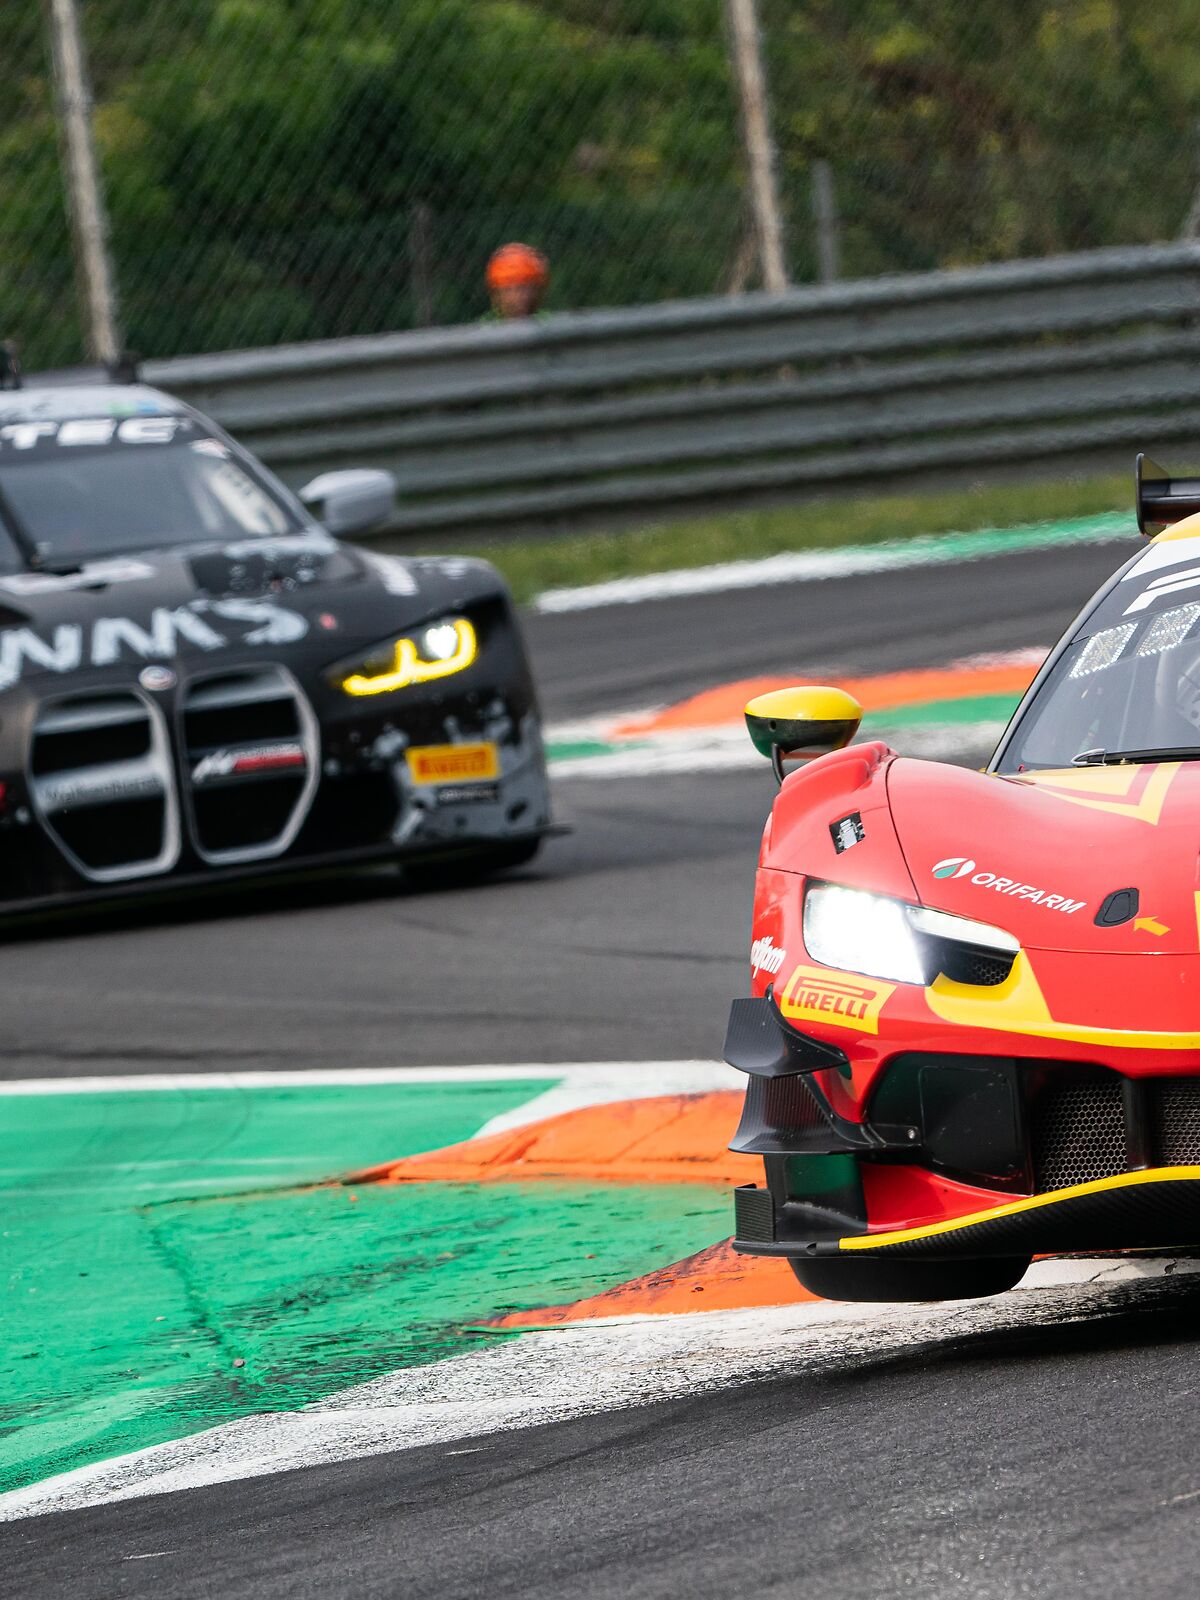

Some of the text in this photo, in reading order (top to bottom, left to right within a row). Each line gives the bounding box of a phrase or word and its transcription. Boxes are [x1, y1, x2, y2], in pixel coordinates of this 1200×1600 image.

[0, 417, 178, 449] TEC
[971, 873, 1087, 914] ORIFARM
[788, 976, 877, 1020] PIRELLI
